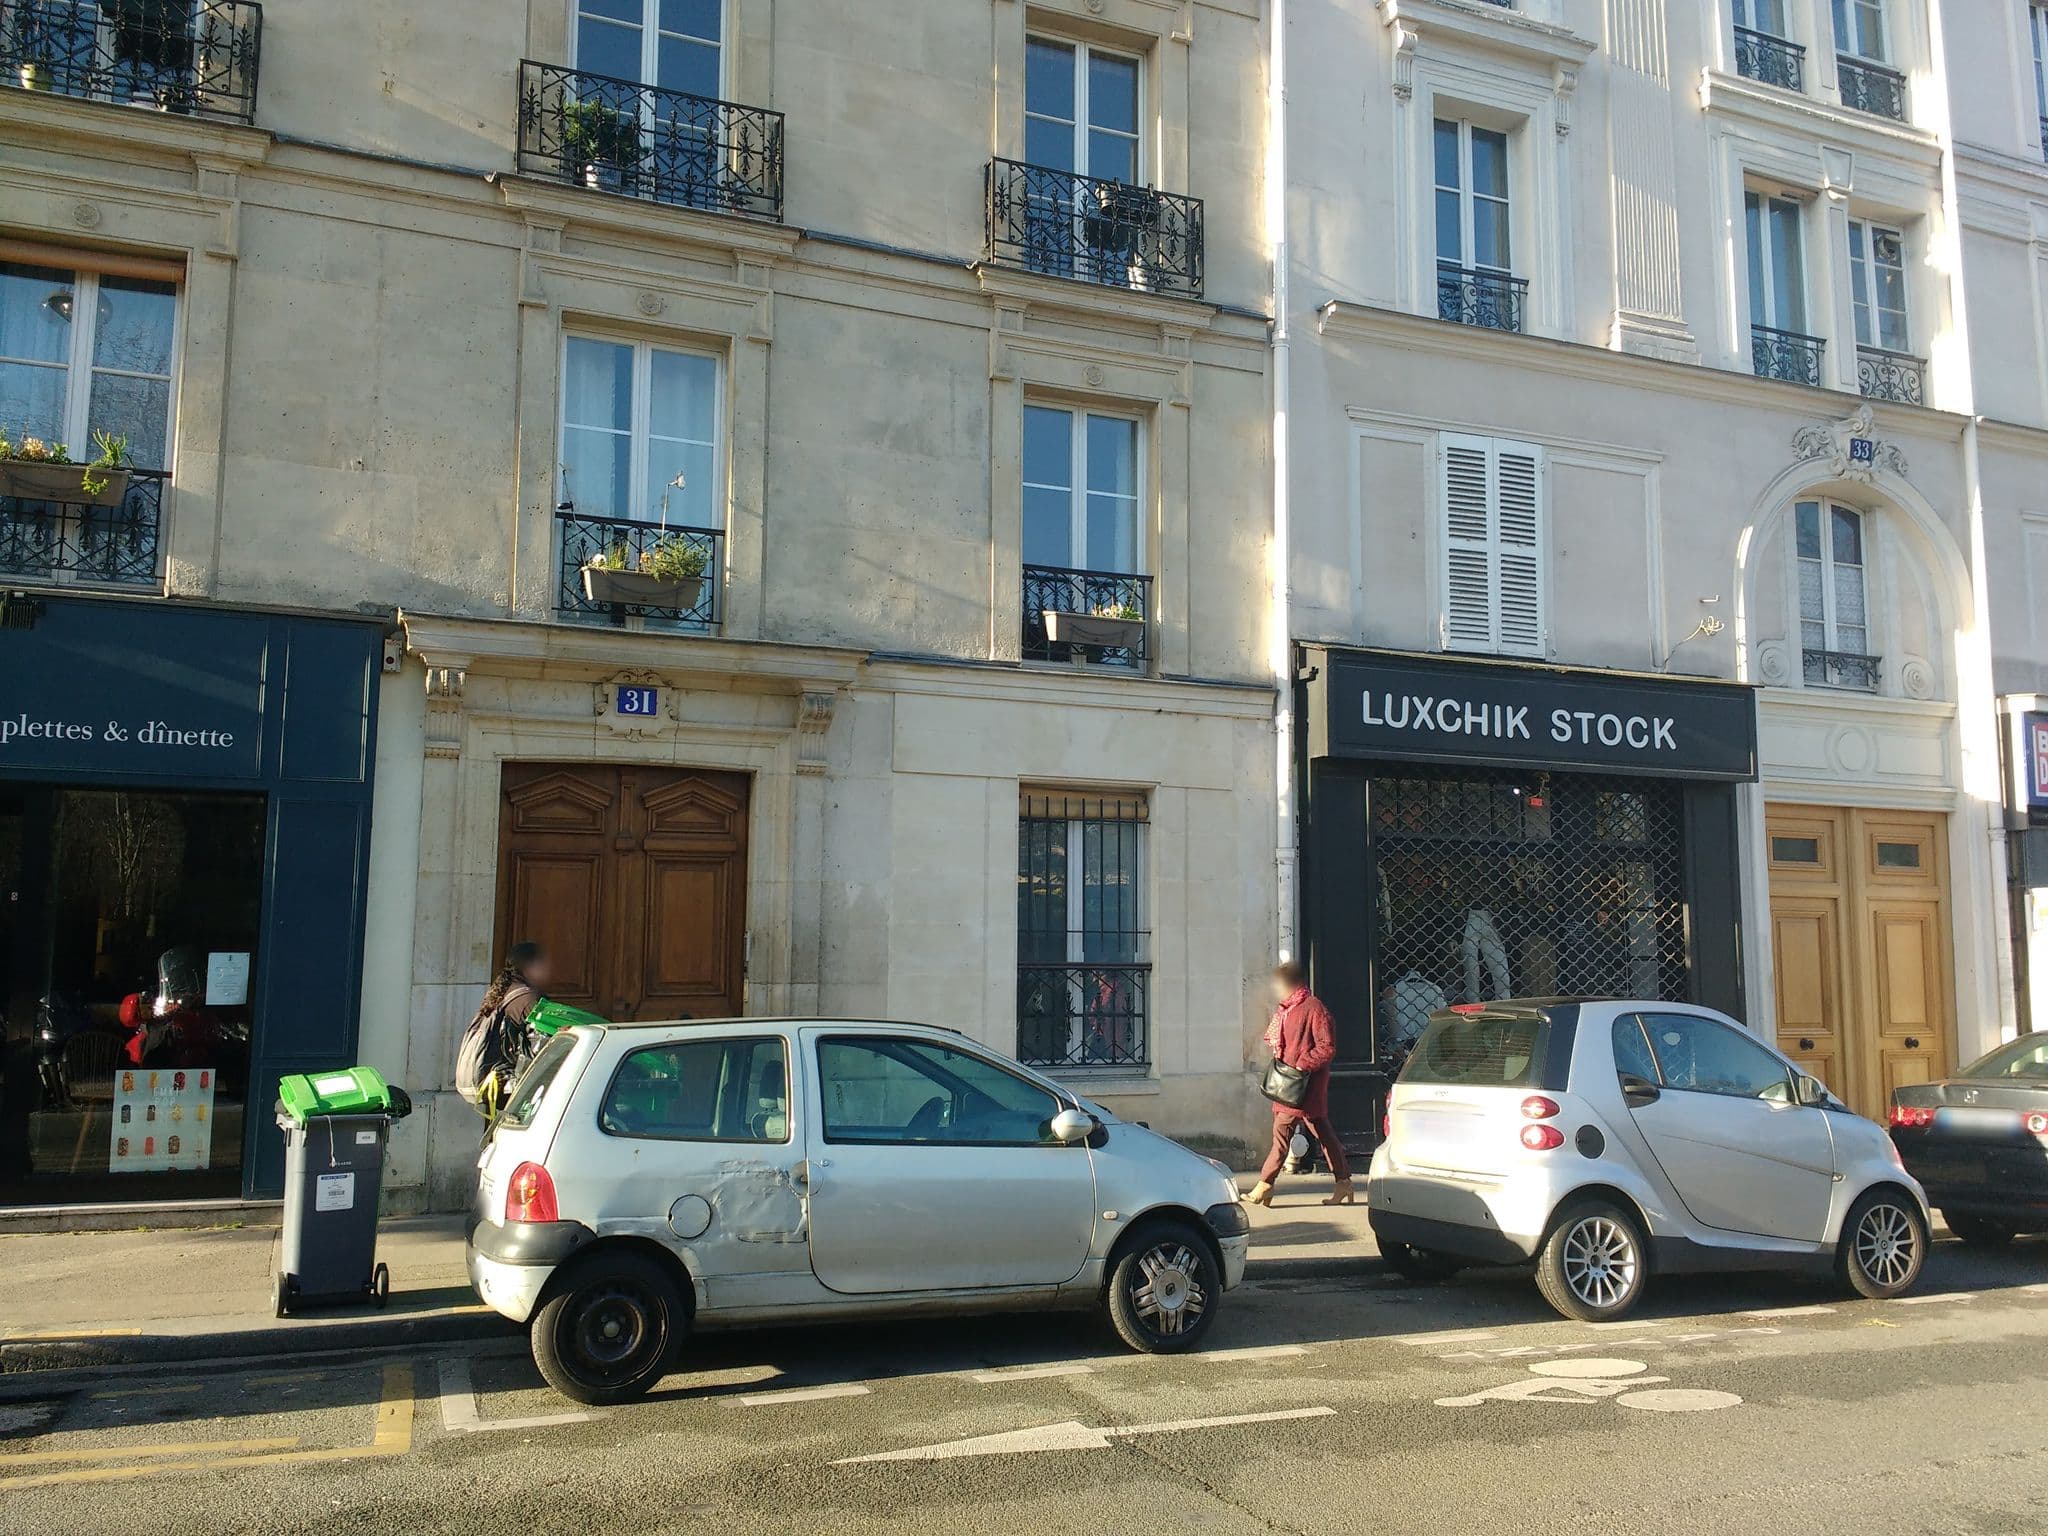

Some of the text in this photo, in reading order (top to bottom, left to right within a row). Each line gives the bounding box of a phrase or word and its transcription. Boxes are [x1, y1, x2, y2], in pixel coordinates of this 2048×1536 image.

[1853, 440, 1870, 459] 33
[624, 690, 651, 713] 31
[0, 713, 235, 748] plettes & dînette
[1361, 690, 1677, 750] LUXCHIK STOCK
